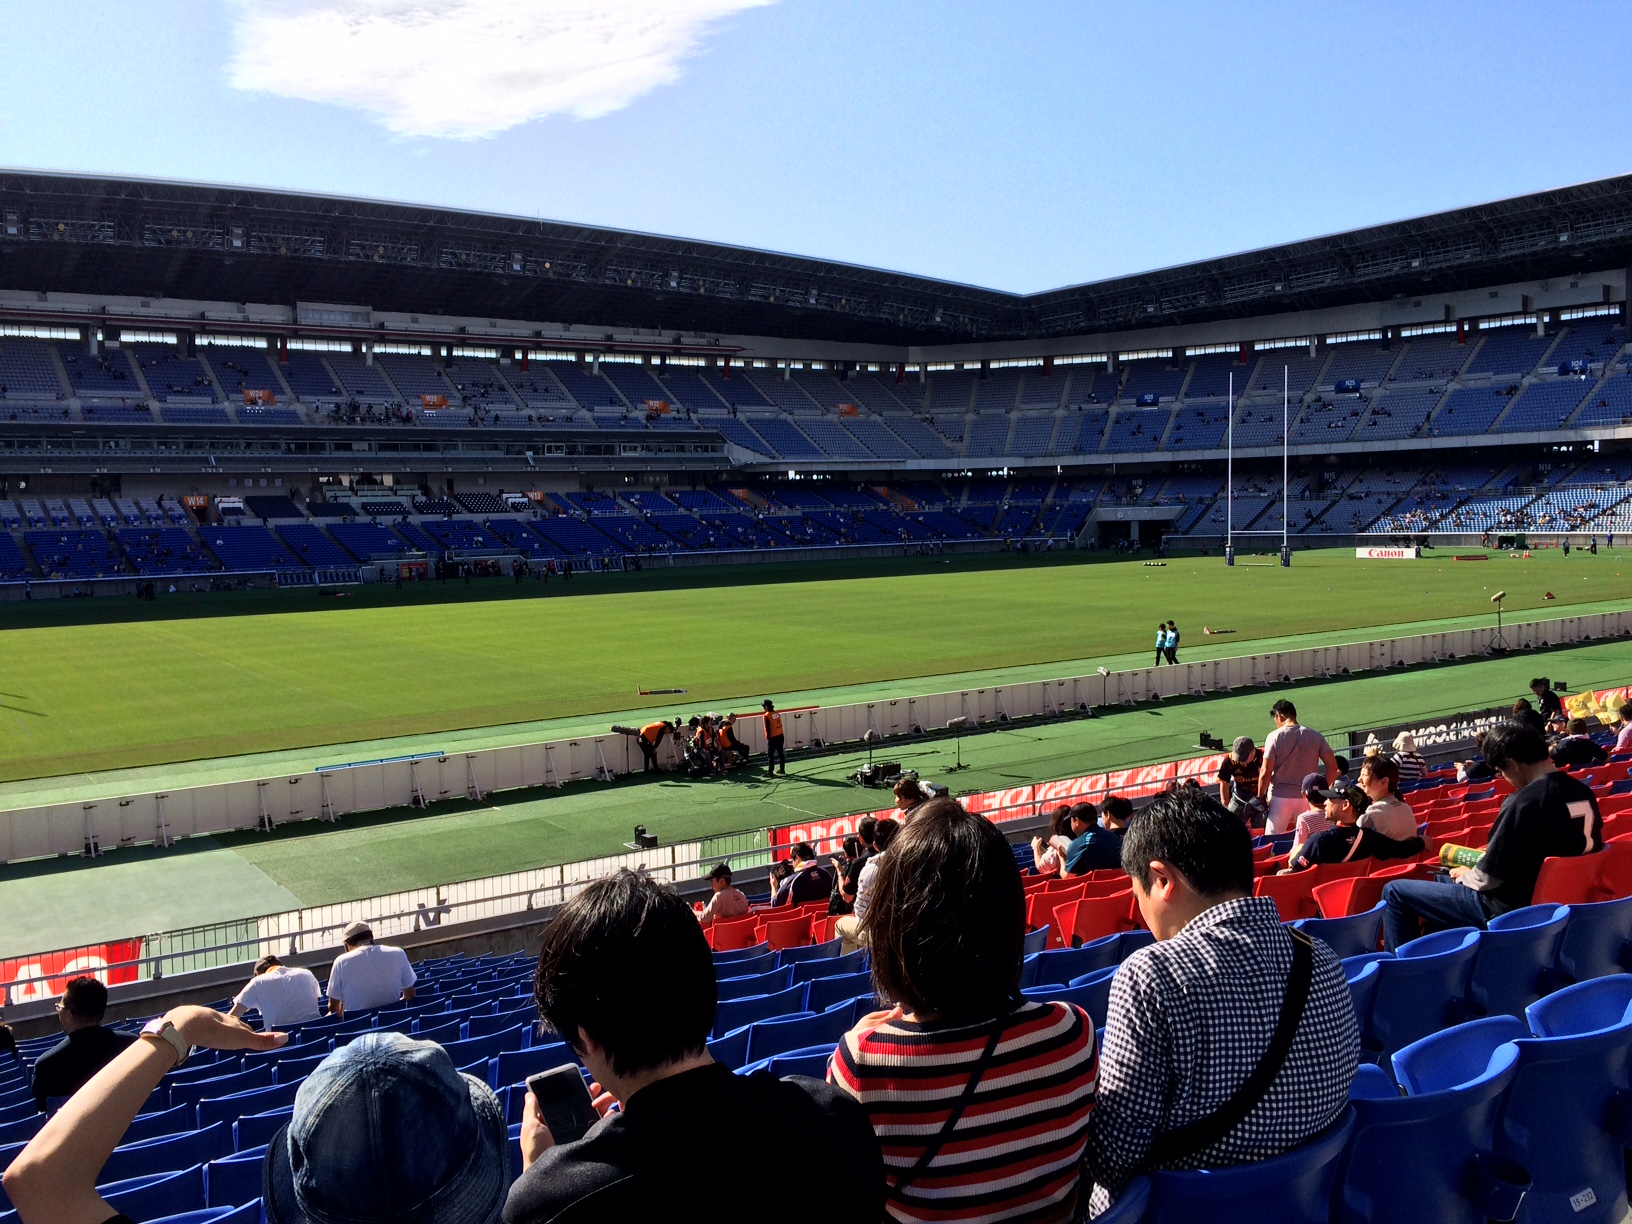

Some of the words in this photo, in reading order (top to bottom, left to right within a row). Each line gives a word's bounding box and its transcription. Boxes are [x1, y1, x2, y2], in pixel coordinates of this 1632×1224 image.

[1571, 360, 1583, 368] N24
[249, 390, 263, 398] W24
[1323, 471, 1336, 479] N15
[187, 496, 204, 505] W14
[1368, 548, 1404, 557] Canon
[1565, 799, 1594, 855] 7
[1573, 1191, 1594, 1208] 15-232
